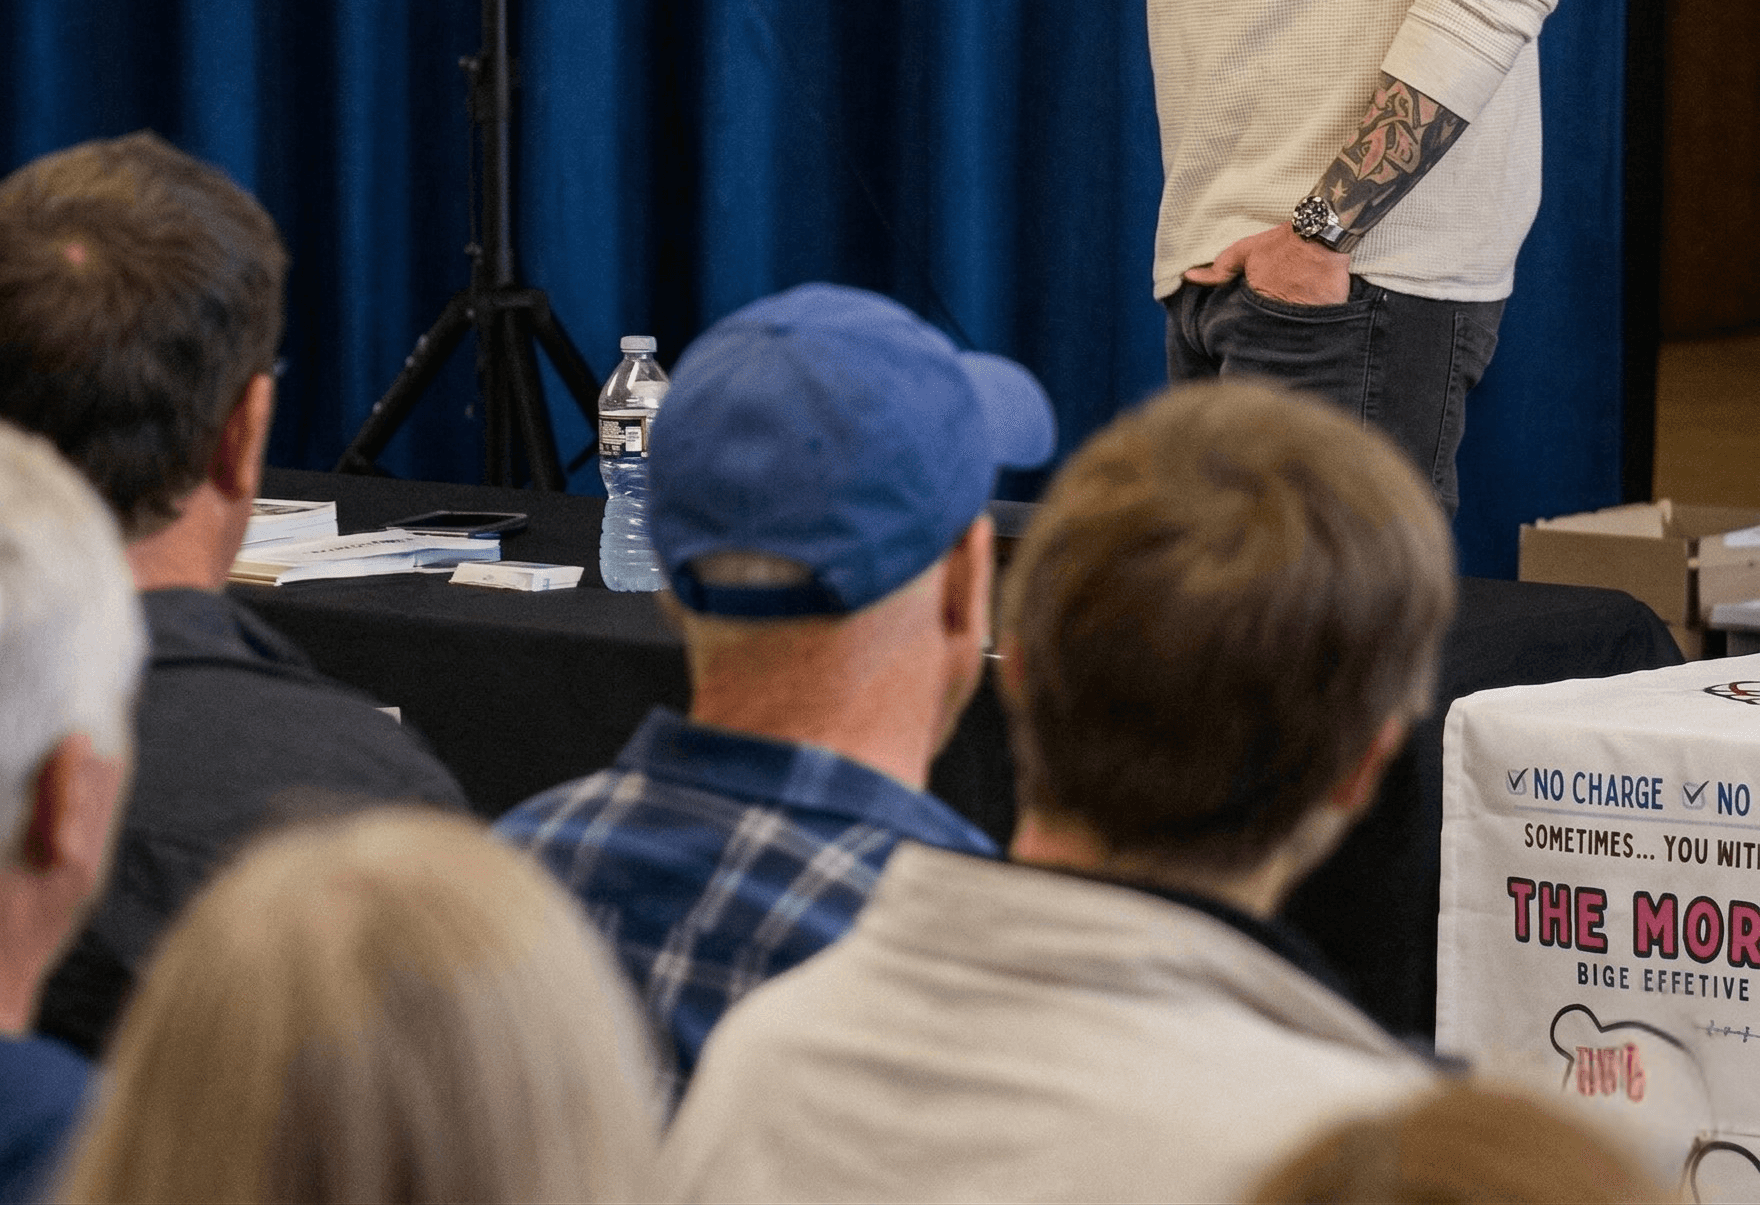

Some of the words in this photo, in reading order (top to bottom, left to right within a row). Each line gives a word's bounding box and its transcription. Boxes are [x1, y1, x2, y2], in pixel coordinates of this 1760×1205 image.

[1533, 768, 1564, 801] NO
[1572, 771, 1664, 810] CHARGE
[1717, 781, 1751, 816] NO
[1524, 823, 1655, 861] SOMETIMES...
[1663, 835, 1708, 864] YOU
[1717, 839, 1760, 870] WIT
[1507, 876, 1608, 955] THE
[1577, 961, 1630, 990] BIGE
[1644, 968, 1750, 1002] EFFETIVE
